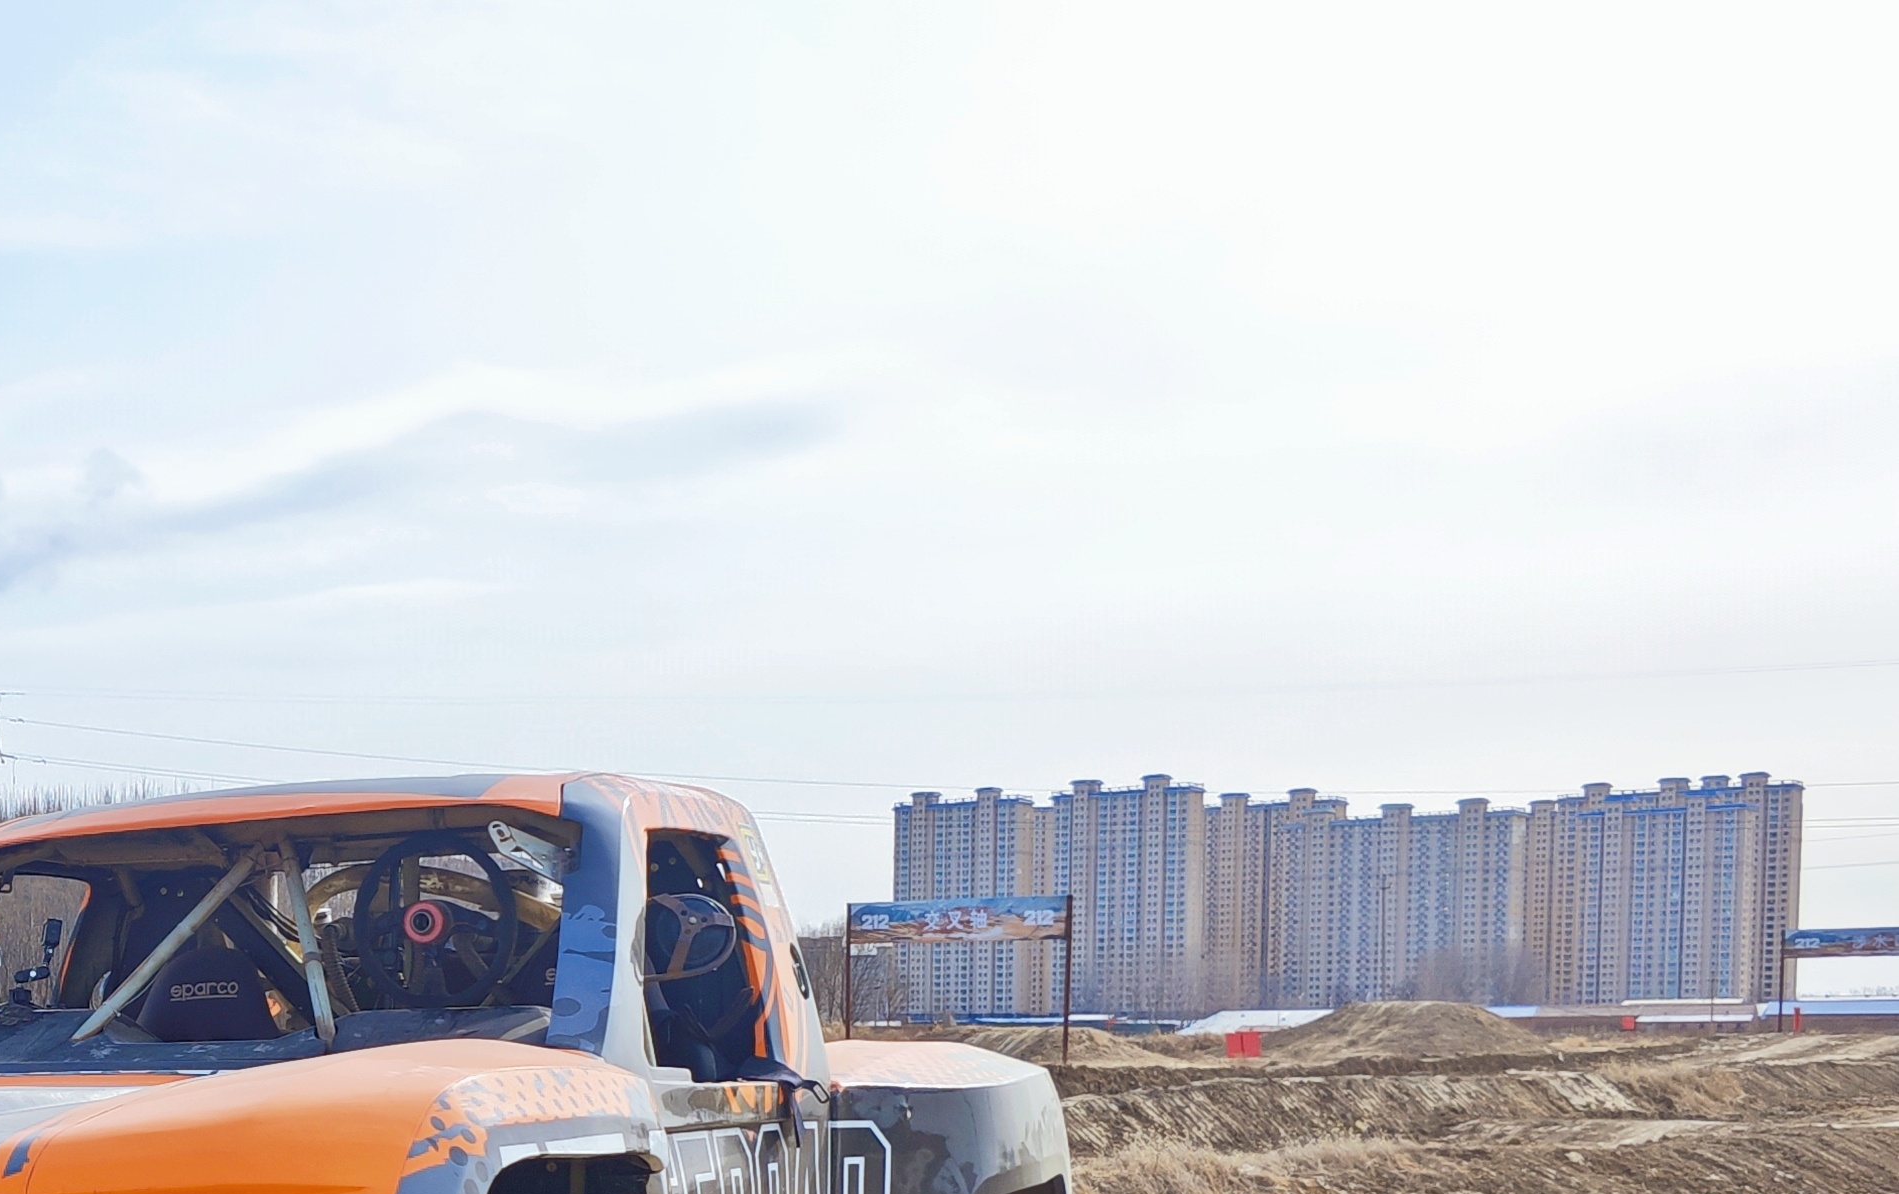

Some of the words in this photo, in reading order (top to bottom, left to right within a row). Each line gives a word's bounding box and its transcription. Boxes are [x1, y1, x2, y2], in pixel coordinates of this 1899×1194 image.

[861, 914, 890, 930] 212
[923, 911, 988, 931] 交叉轴
[1023, 909, 1055, 926] 212
[1794, 937, 1820, 949] 212
[170, 981, 239, 1001] sparco
